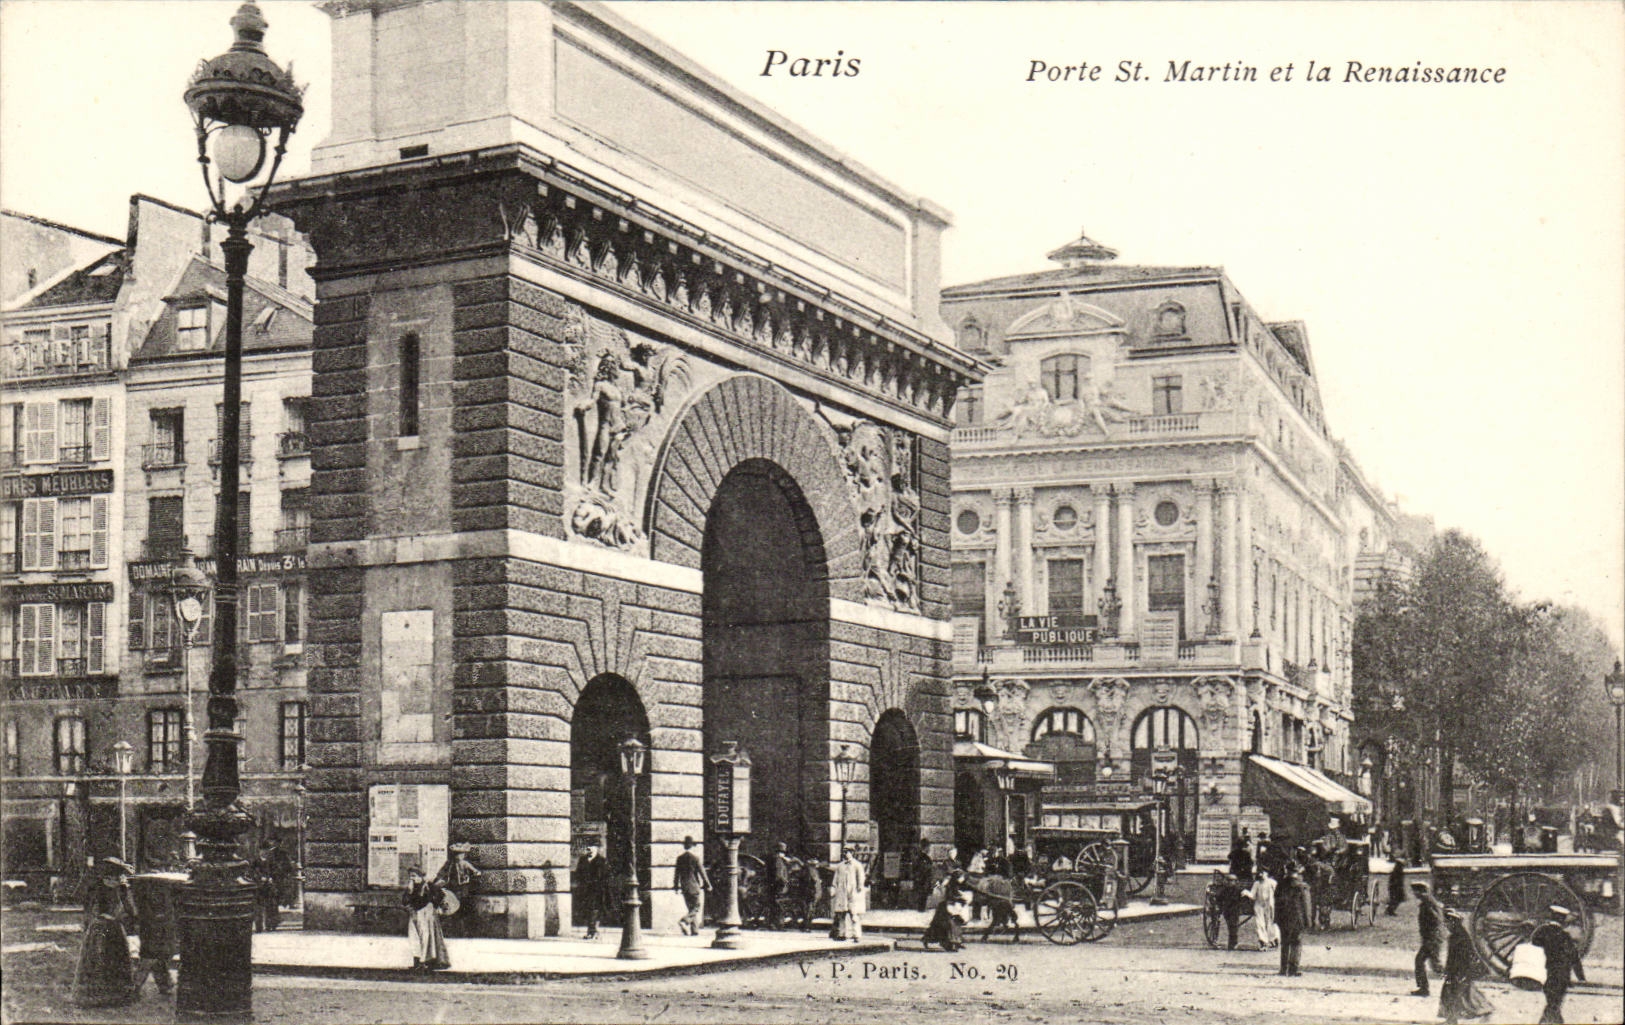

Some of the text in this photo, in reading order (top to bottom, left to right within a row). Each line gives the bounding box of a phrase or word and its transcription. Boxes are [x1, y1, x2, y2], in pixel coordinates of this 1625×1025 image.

[0, 478, 37, 496] BRES
[1020, 615, 1059, 629] LA VIE
[1032, 630, 1093, 643] PUBLIQUE
[718, 769, 730, 825] DUFAYEL
